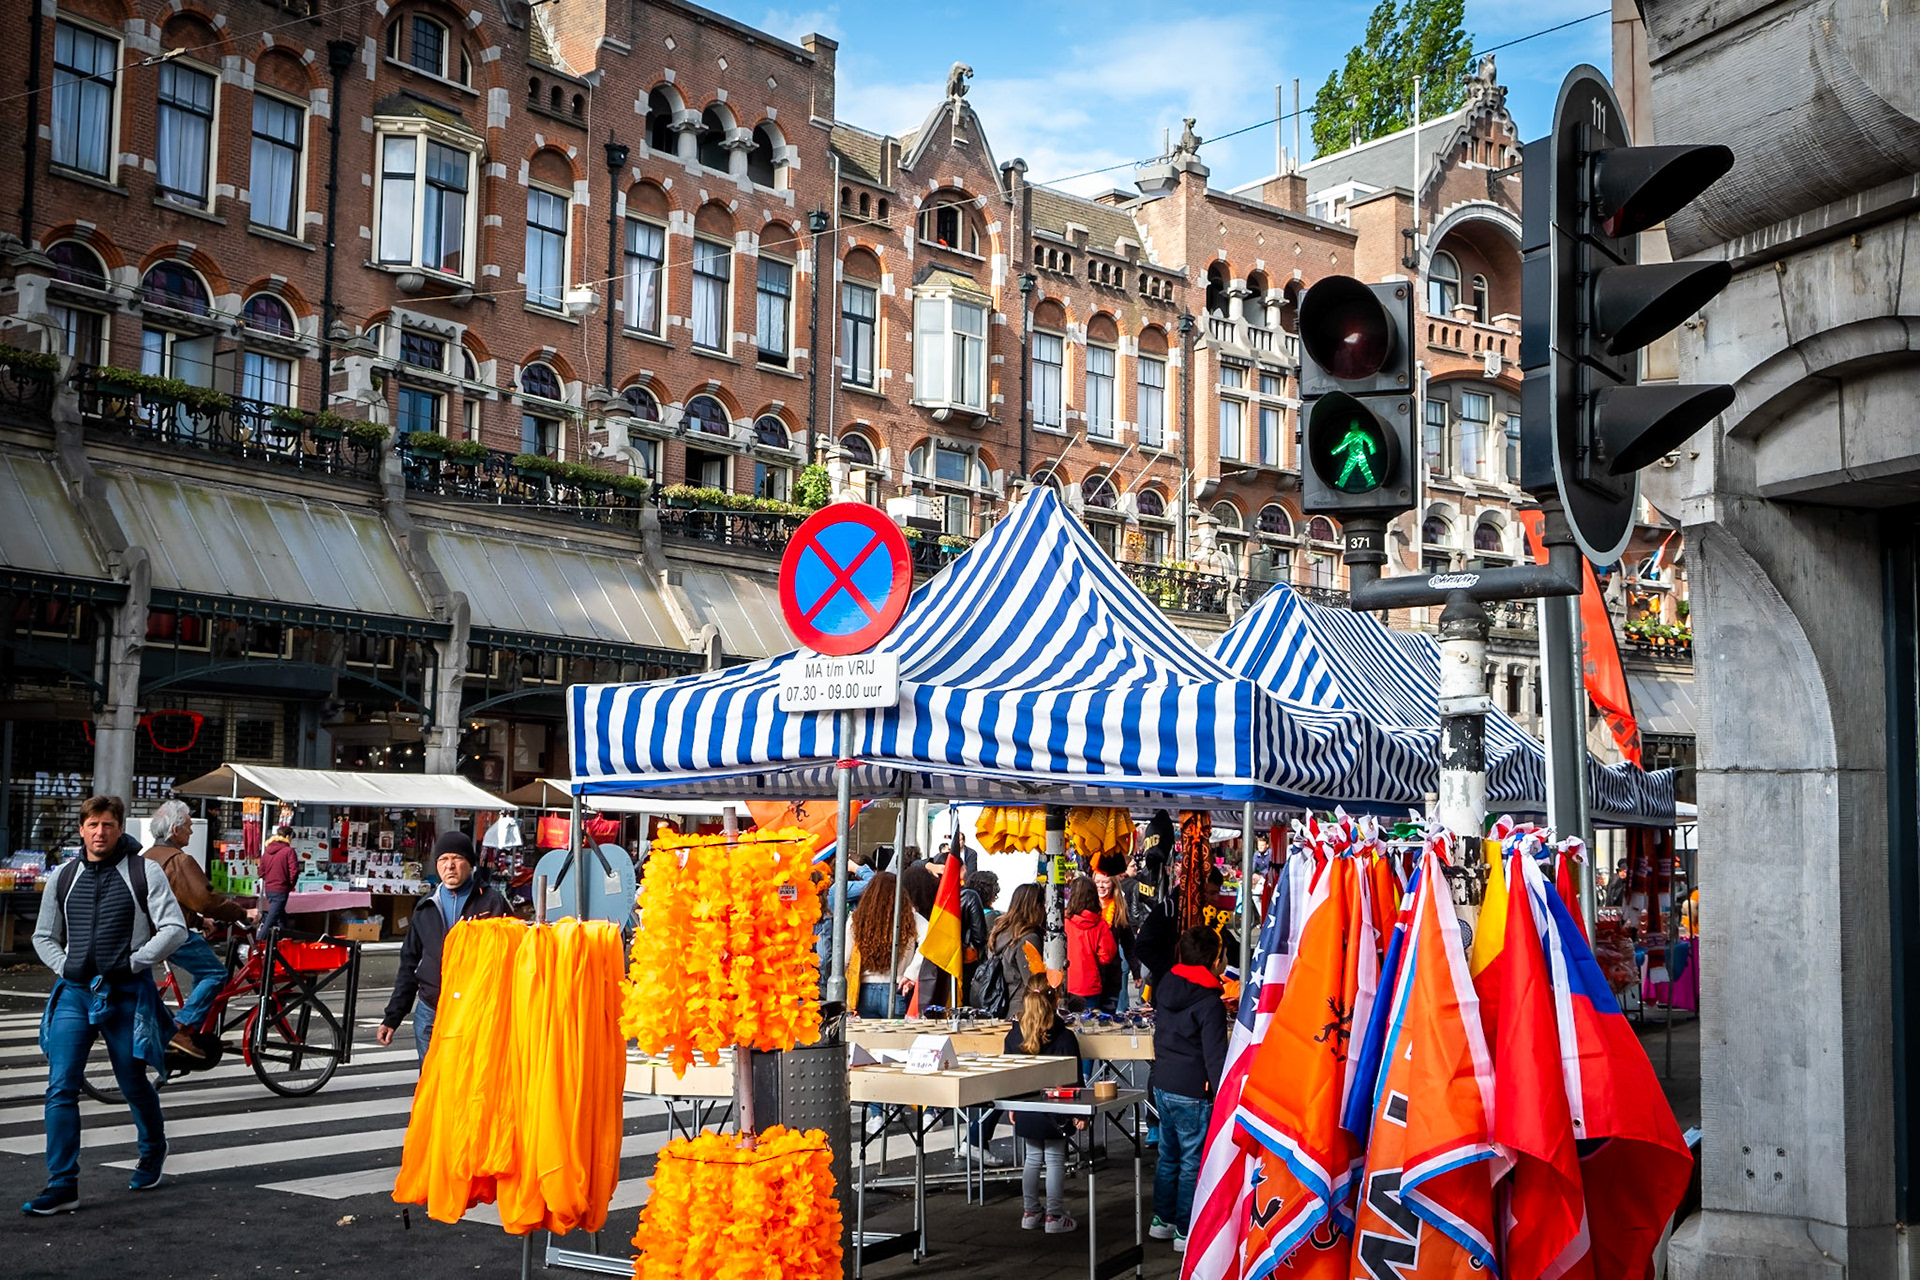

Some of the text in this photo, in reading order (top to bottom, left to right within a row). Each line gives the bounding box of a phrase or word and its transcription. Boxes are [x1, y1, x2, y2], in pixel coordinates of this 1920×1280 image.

[1591, 97, 1606, 135] 111
[1350, 537, 1371, 549] 371
[805, 659, 875, 678] MA t/m VRIJ
[786, 685, 817, 702] 07.30
[828, 683, 859, 699] 09.00
[863, 685, 882, 698] uur
[35, 771, 82, 797] DAS
